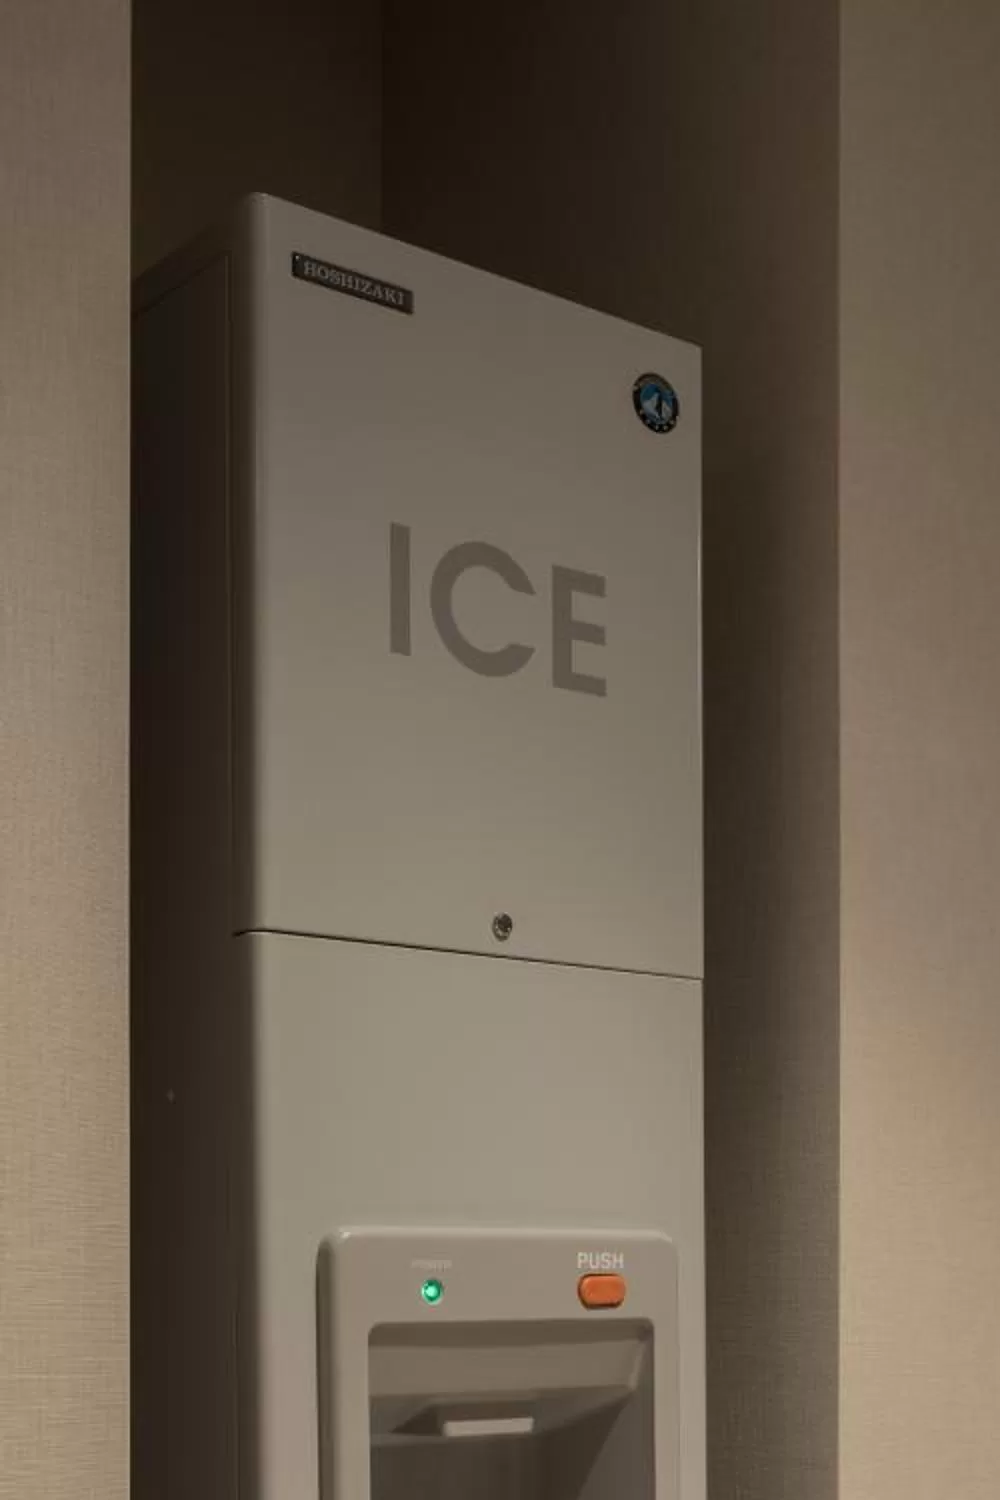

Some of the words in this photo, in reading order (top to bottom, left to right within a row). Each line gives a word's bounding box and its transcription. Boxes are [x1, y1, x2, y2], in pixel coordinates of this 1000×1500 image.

[304, 260, 405, 305] HOSHIZAKI
[389, 521, 608, 698] ICE
[576, 1251, 625, 1270] PUSH
